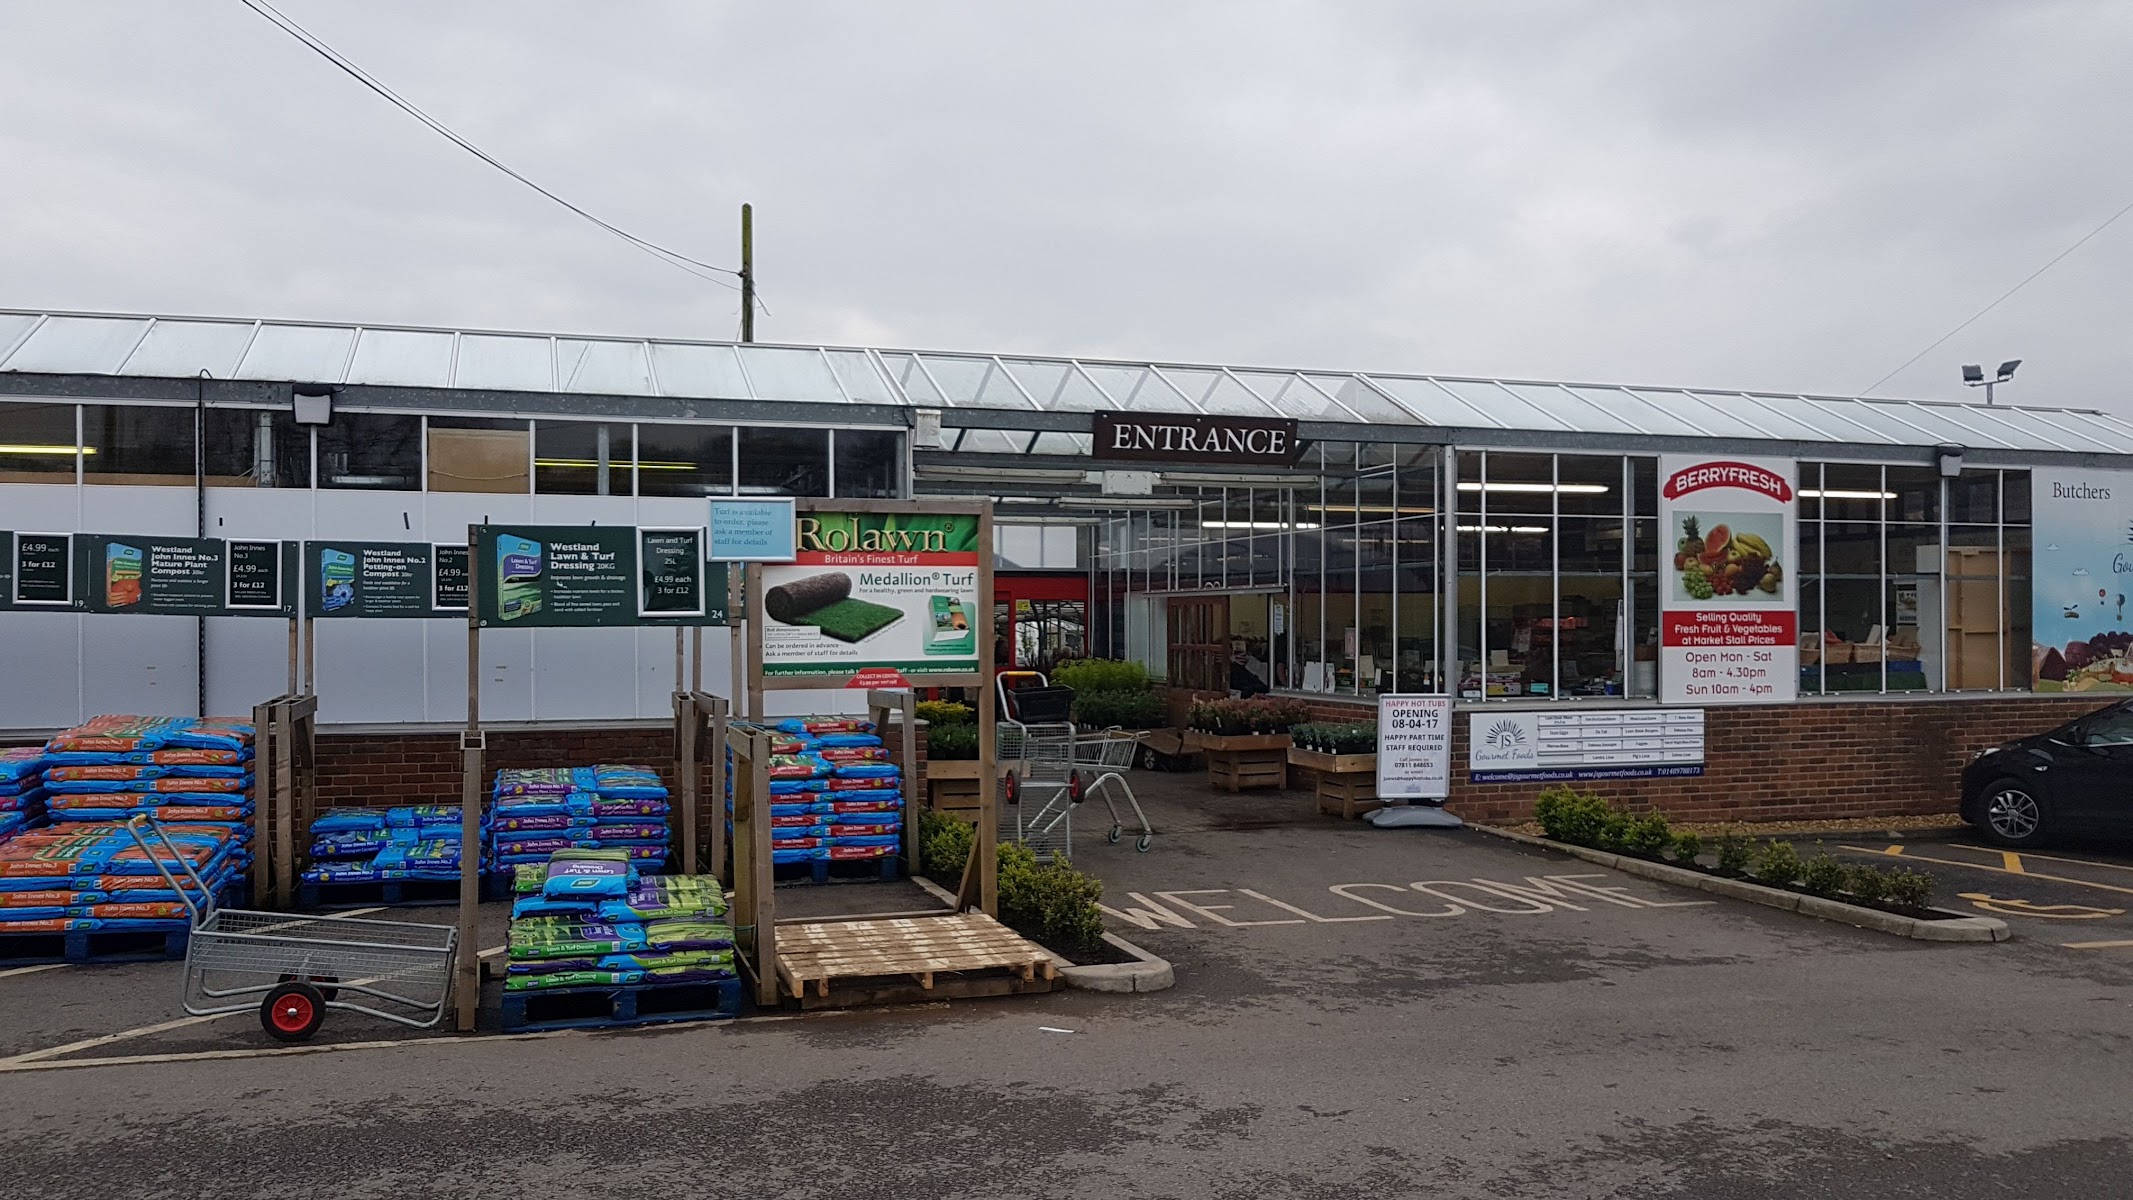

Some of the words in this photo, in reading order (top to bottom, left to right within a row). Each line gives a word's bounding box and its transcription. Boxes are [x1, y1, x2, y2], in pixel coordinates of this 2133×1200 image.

[1112, 424, 1286, 454] ENTRANCE
[1675, 467, 1781, 496] BERRYFRESH
[2052, 482, 2111, 500] Butchers
[746, 519, 769, 527] please
[22, 543, 47, 552] £4.99
[151, 546, 193, 554] Westland
[550, 542, 600, 551] Westland
[198, 554, 219, 562] No.3
[550, 552, 578, 560] Lawn
[581, 552, 589, 560] &
[592, 552, 615, 560] Turf
[824, 554, 865, 564] Britain's
[866, 554, 896, 564] Finest
[898, 554, 919, 564] Turf
[233, 564, 257, 573] £4.99
[363, 564, 407, 572] Potting-on
[550, 562, 595, 571] Dressing
[151, 568, 191, 576] Compost
[439, 568, 461, 576] £4.99
[942, 572, 975, 586] Turf
[74, 600, 84, 608] 19
[712, 610, 723, 619] 24
[1696, 613, 1727, 623] Selling
[1729, 613, 1761, 624] Quality
[1675, 624, 1700, 634] Fresh
[1701, 624, 1722, 634] Fruit
[1723, 624, 1730, 634] &
[1732, 625, 1783, 635] Vegetables
[1682, 636, 1692, 645] at
[1693, 636, 1723, 645] Market
[1725, 636, 1745, 645] Stall
[1748, 636, 1776, 645] Prices
[1685, 652, 1717, 665] Open
[1720, 652, 1744, 662] Mon
[1753, 652, 1772, 662] Sat
[1692, 668, 1716, 678] 8am
[1727, 668, 1766, 681] 4.30pm
[1686, 684, 1708, 695] Sun
[1711, 684, 1739, 694] 10am
[1749, 684, 1773, 696] 4pm
[1392, 710, 1439, 718] OPENING
[1392, 719, 1438, 729] 08-04-17
[1501, 734, 1511, 748] JS
[1475, 749, 1508, 761] Gourmet
[1512, 749, 1534, 760] Foods
[1093, 873, 1719, 931] WELCOME
[547, 945, 559, 953] Lawn
[577, 944, 598, 952] Dressing
